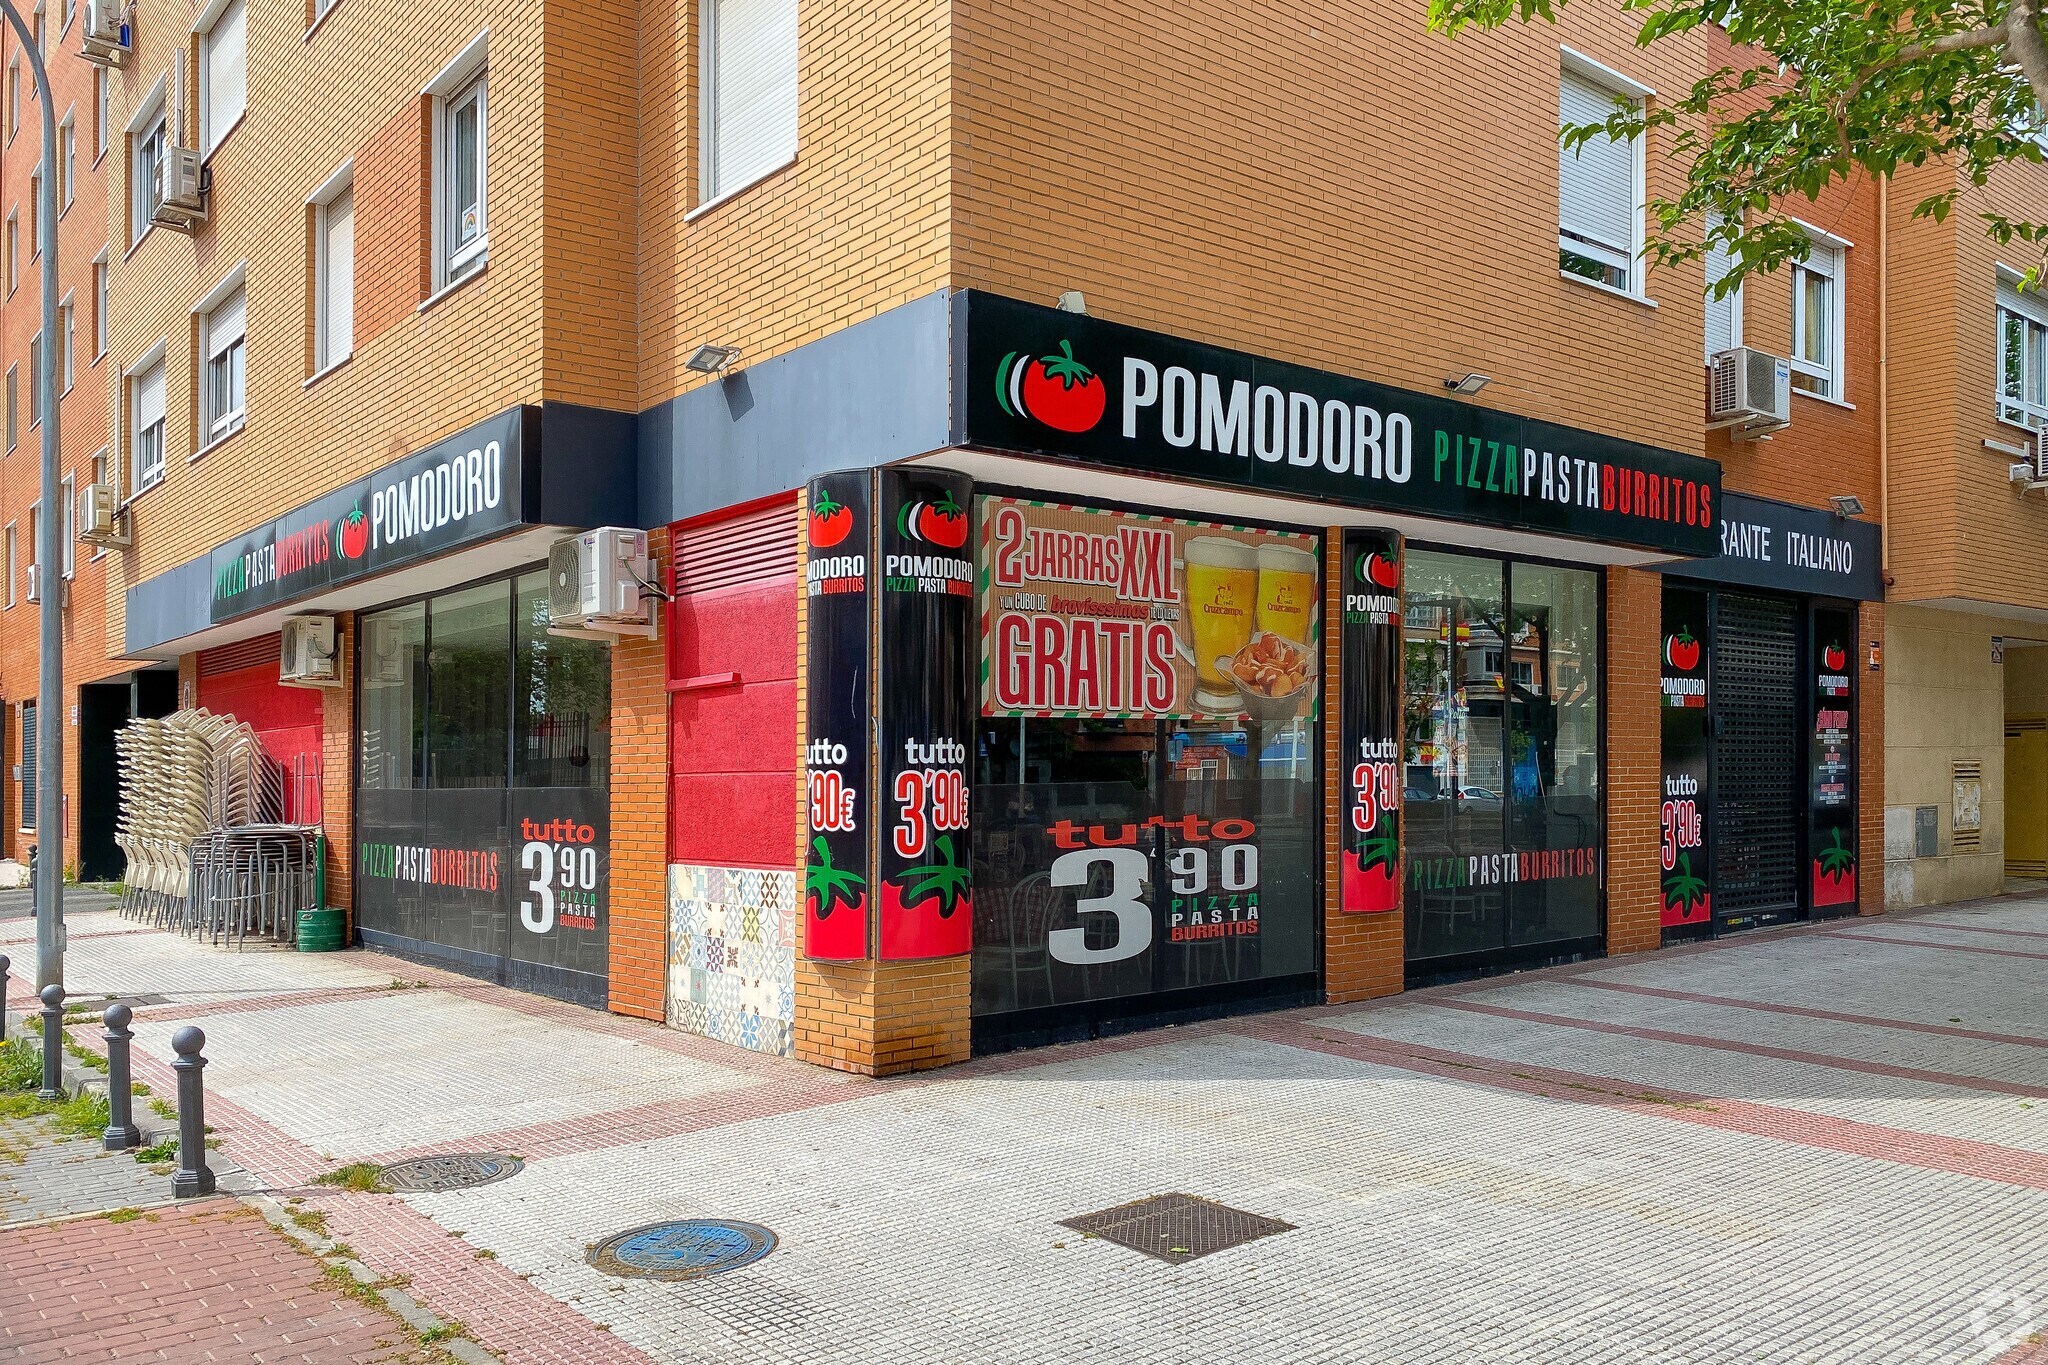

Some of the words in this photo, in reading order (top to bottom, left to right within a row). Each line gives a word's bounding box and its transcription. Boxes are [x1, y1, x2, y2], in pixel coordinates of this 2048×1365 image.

[1123, 356, 1412, 484] POMODORO
[372, 440, 501, 549] POMODORO
[995, 506, 1025, 587] 2
[1022, 527, 1120, 586] JARRAS
[1116, 525, 1181, 602] XXL
[1720, 519, 1771, 562] RANTE
[1787, 531, 1853, 574] ITALIANO
[886, 555, 973, 583] POMODORO
[823, 577, 864, 595] BURRITOS
[886, 577, 915, 593] PIZZA
[918, 577, 946, 594] PASTA
[1015, 592, 1035, 610] CUBO
[1037, 594, 1047, 611] DE
[1203, 603, 1244, 617] Cruzcampo
[1267, 602, 1302, 614] Cruzcampo
[1346, 612, 1368, 624] PIZZA
[1370, 612, 1389, 625] PASTA
[995, 611, 1177, 713] GRATIS
[905, 736, 965, 765] tutto
[1360, 737, 1398, 759] tutto
[1666, 774, 1698, 796] tutto
[521, 816, 595, 843] tutto
[560, 890, 596, 906] PIZZA
[1171, 892, 1258, 913] PIZZA
[560, 903, 596, 918] PASTA
[1171, 907, 1258, 927] PASTA
[560, 914, 596, 930] BURRITOS
[1171, 919, 1258, 942] BURRITOS
